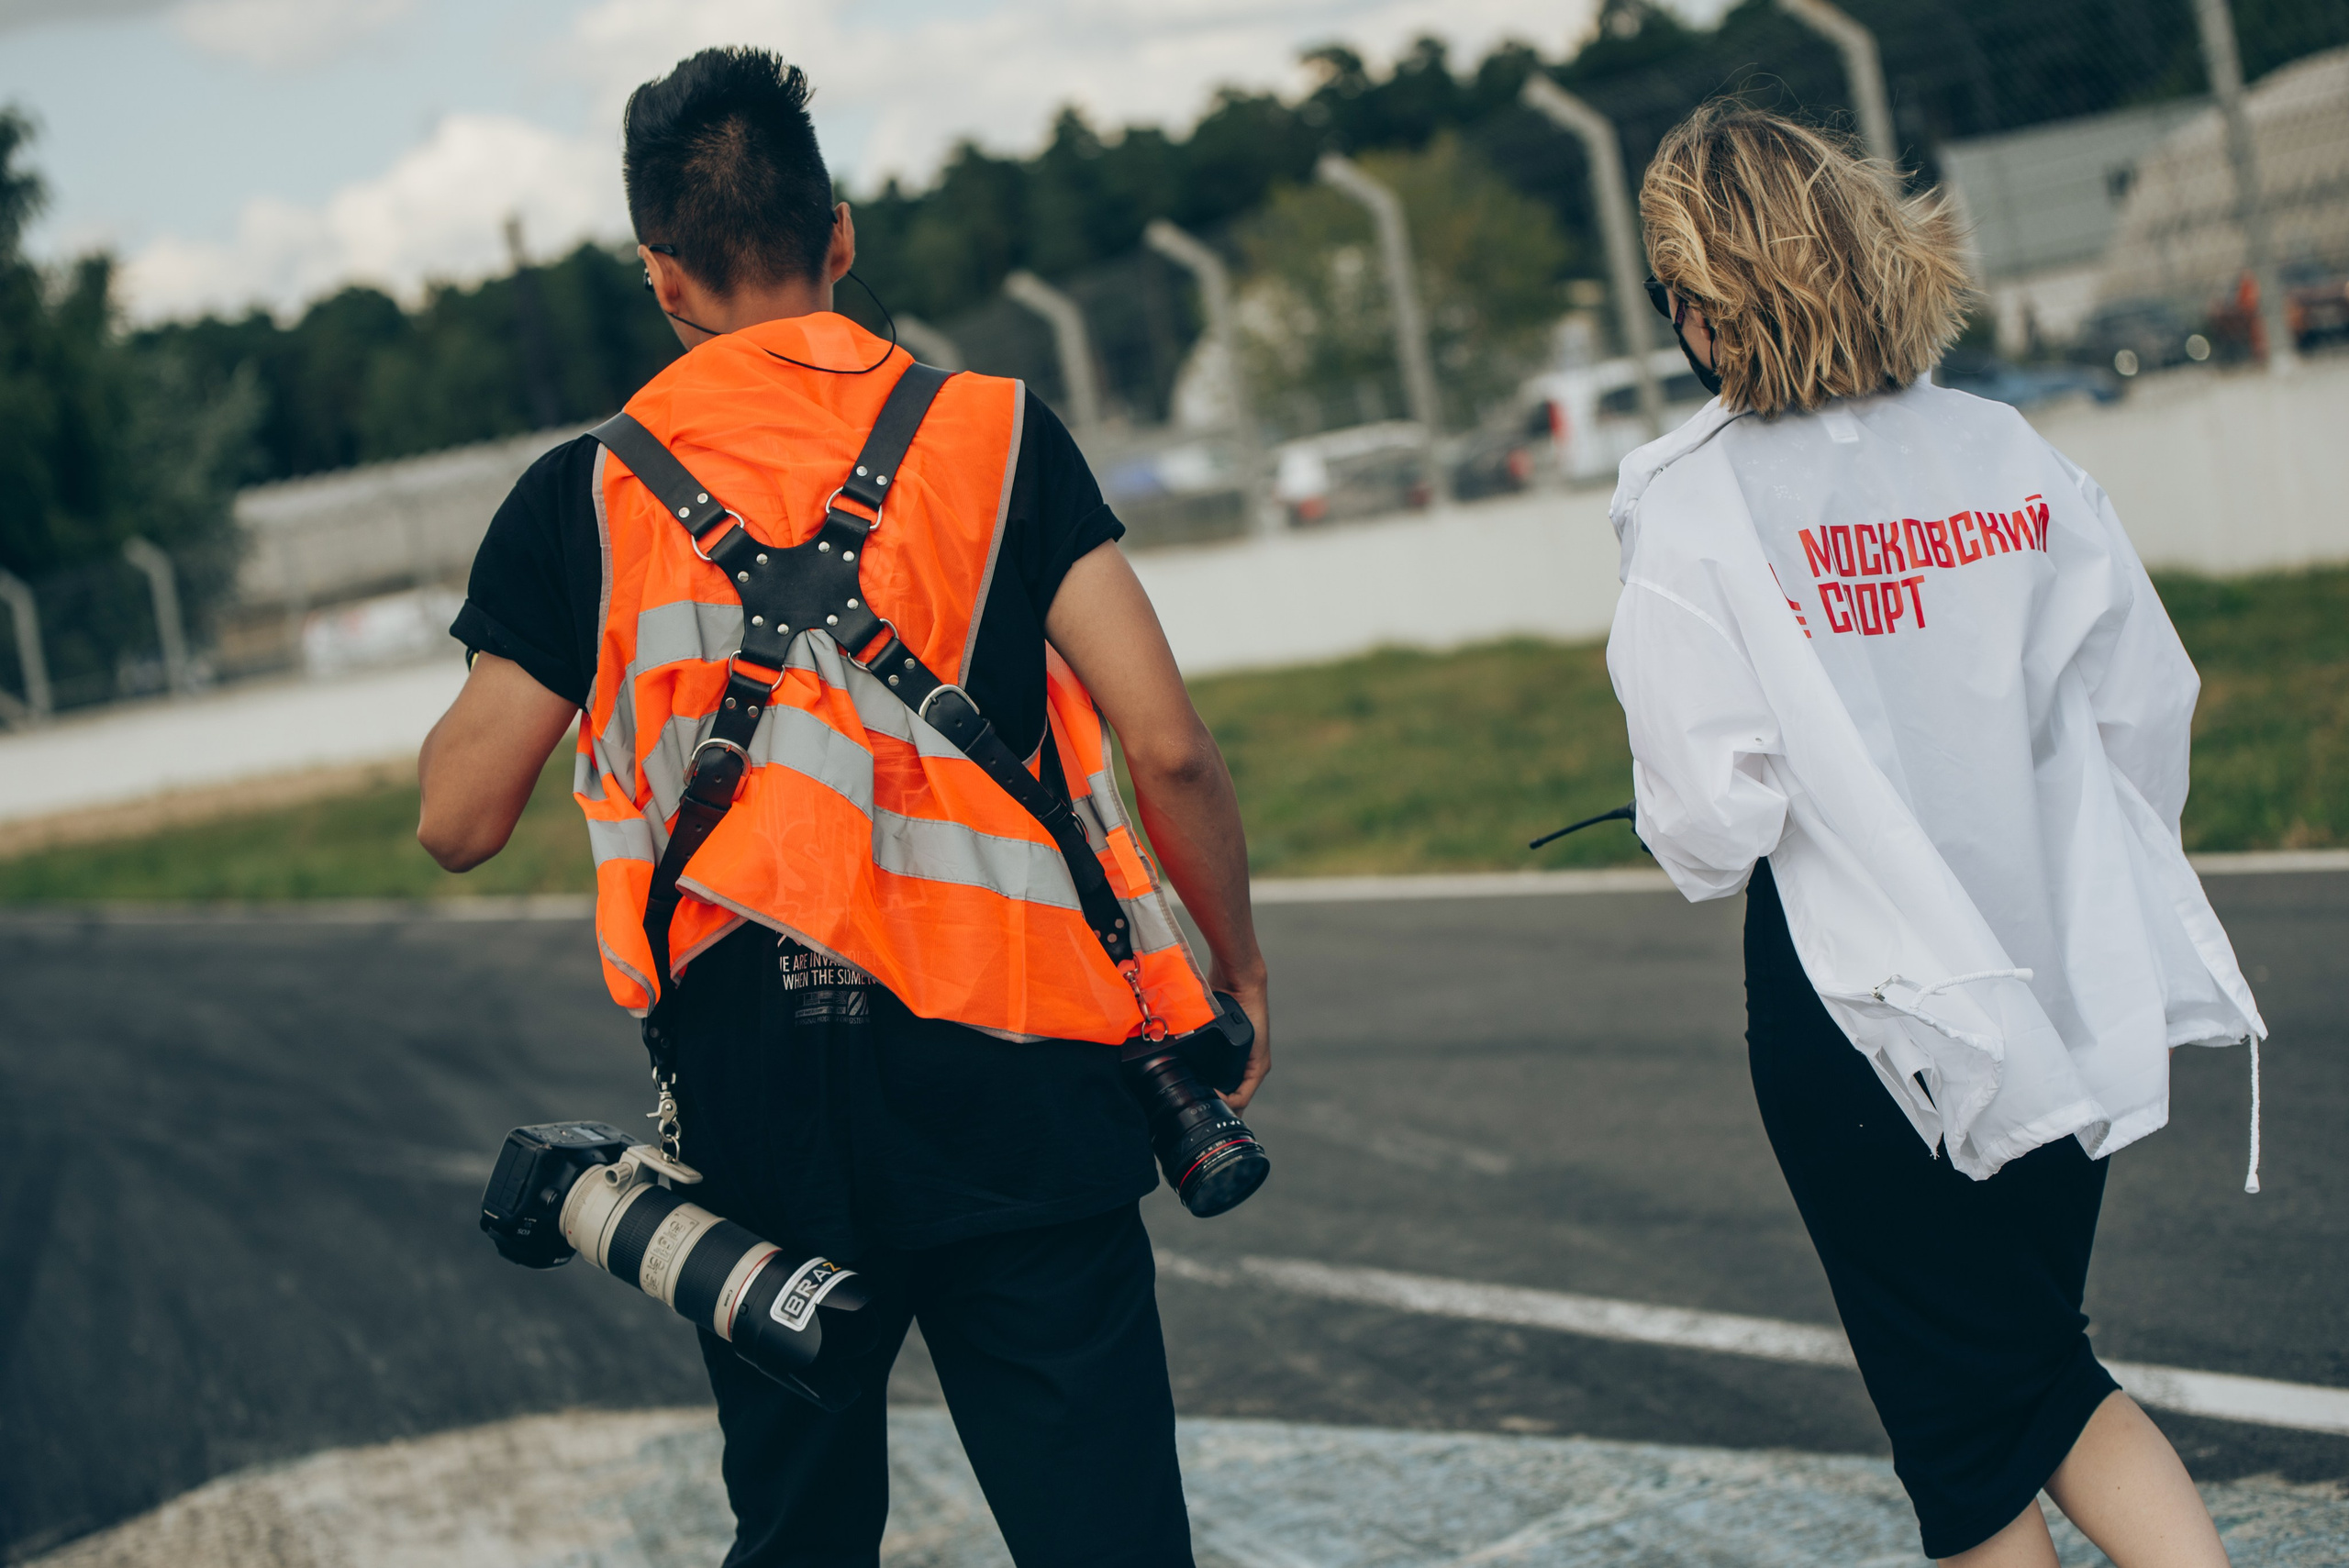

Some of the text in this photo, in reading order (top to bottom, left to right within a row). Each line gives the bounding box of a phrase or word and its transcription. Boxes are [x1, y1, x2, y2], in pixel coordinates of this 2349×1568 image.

[793, 952, 808, 972] ARE
[783, 971, 808, 991] WHEN
[811, 968, 834, 986] THE
